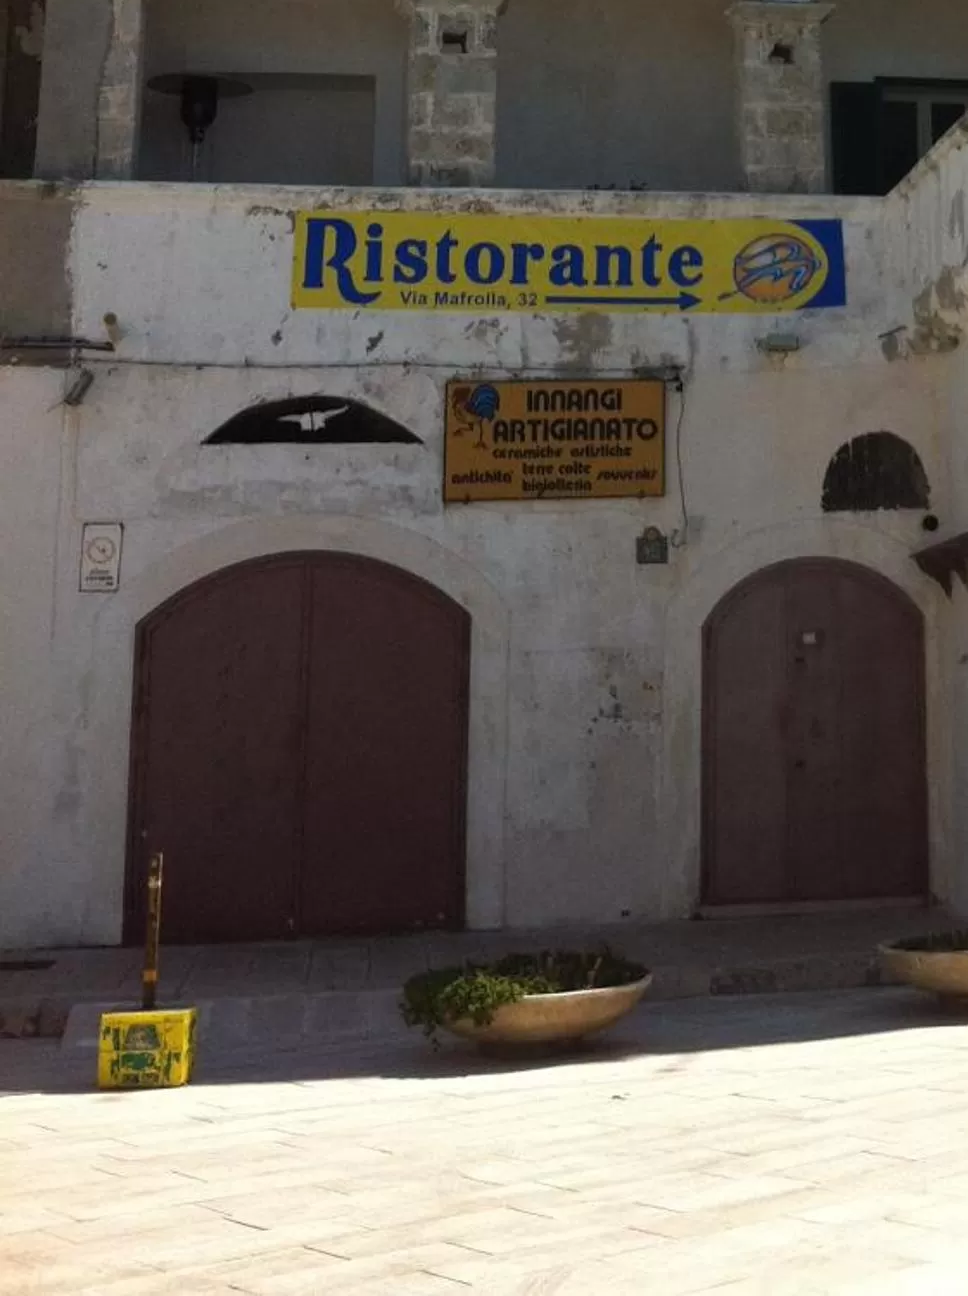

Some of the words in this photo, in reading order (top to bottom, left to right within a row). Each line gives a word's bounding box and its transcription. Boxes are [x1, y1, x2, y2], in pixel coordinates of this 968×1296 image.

[302, 217, 704, 304] Ristorante
[400, 291, 428, 305] Via
[518, 292, 538, 306] 32
[493, 417, 658, 443] ARTIGIANATO
